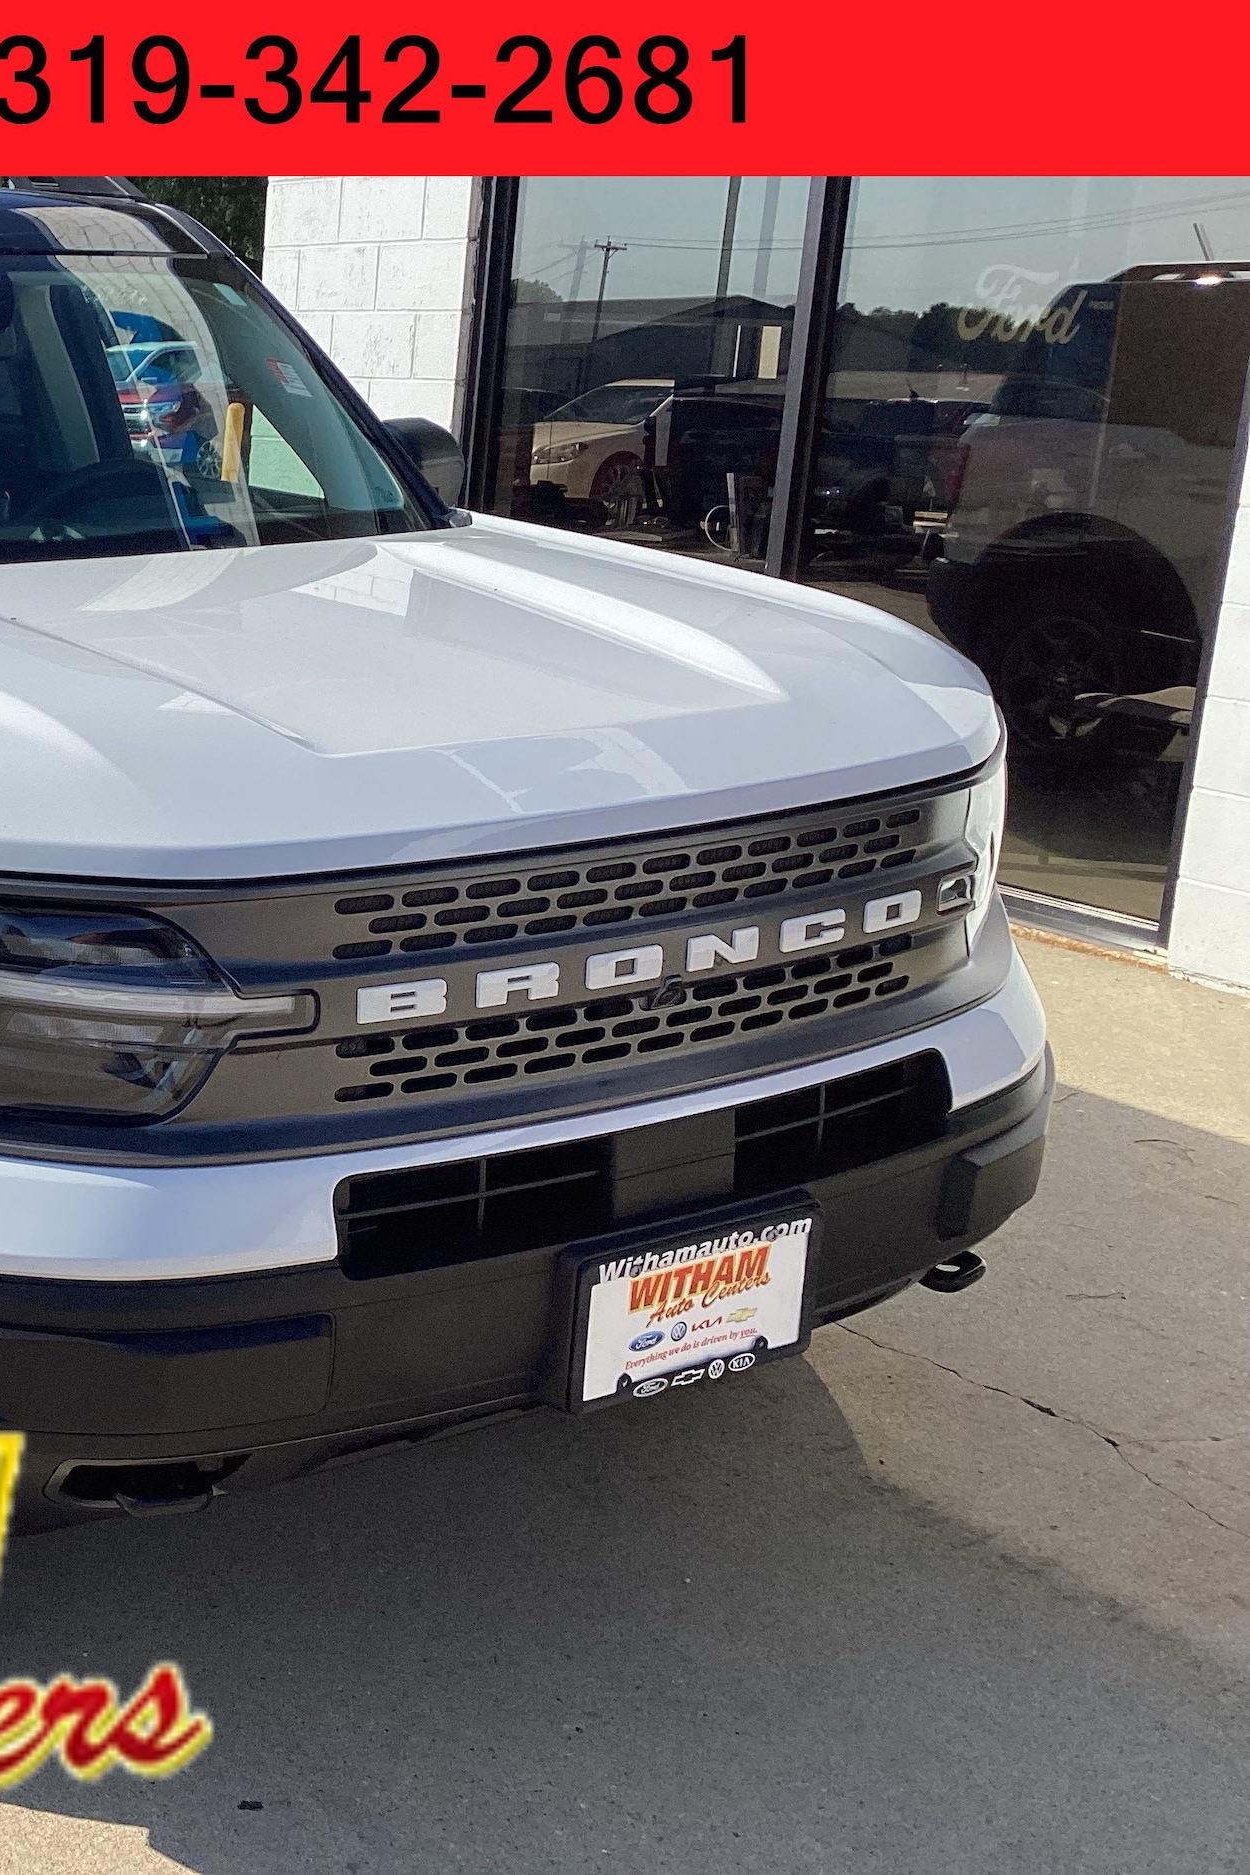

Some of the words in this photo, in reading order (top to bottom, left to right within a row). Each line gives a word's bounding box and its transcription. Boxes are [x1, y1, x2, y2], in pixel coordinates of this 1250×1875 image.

[956, 264, 1089, 344] Ford
[356, 890, 922, 1026] BRONCO
[598, 1218, 812, 1284] Withamauto.com
[629, 1246, 771, 1313] WITHAM
[646, 1299, 694, 1329] Auto
[701, 1271, 771, 1309] Centers
[625, 1351, 668, 1370] Everything
[668, 1346, 680, 1356] we
[681, 1342, 692, 1352] do
[693, 1339, 700, 1349] is
[701, 1333, 728, 1347] driven
[729, 1329, 739, 1341] by
[740, 1326, 758, 1339] you.
[732, 1356, 752, 1370] KIA
